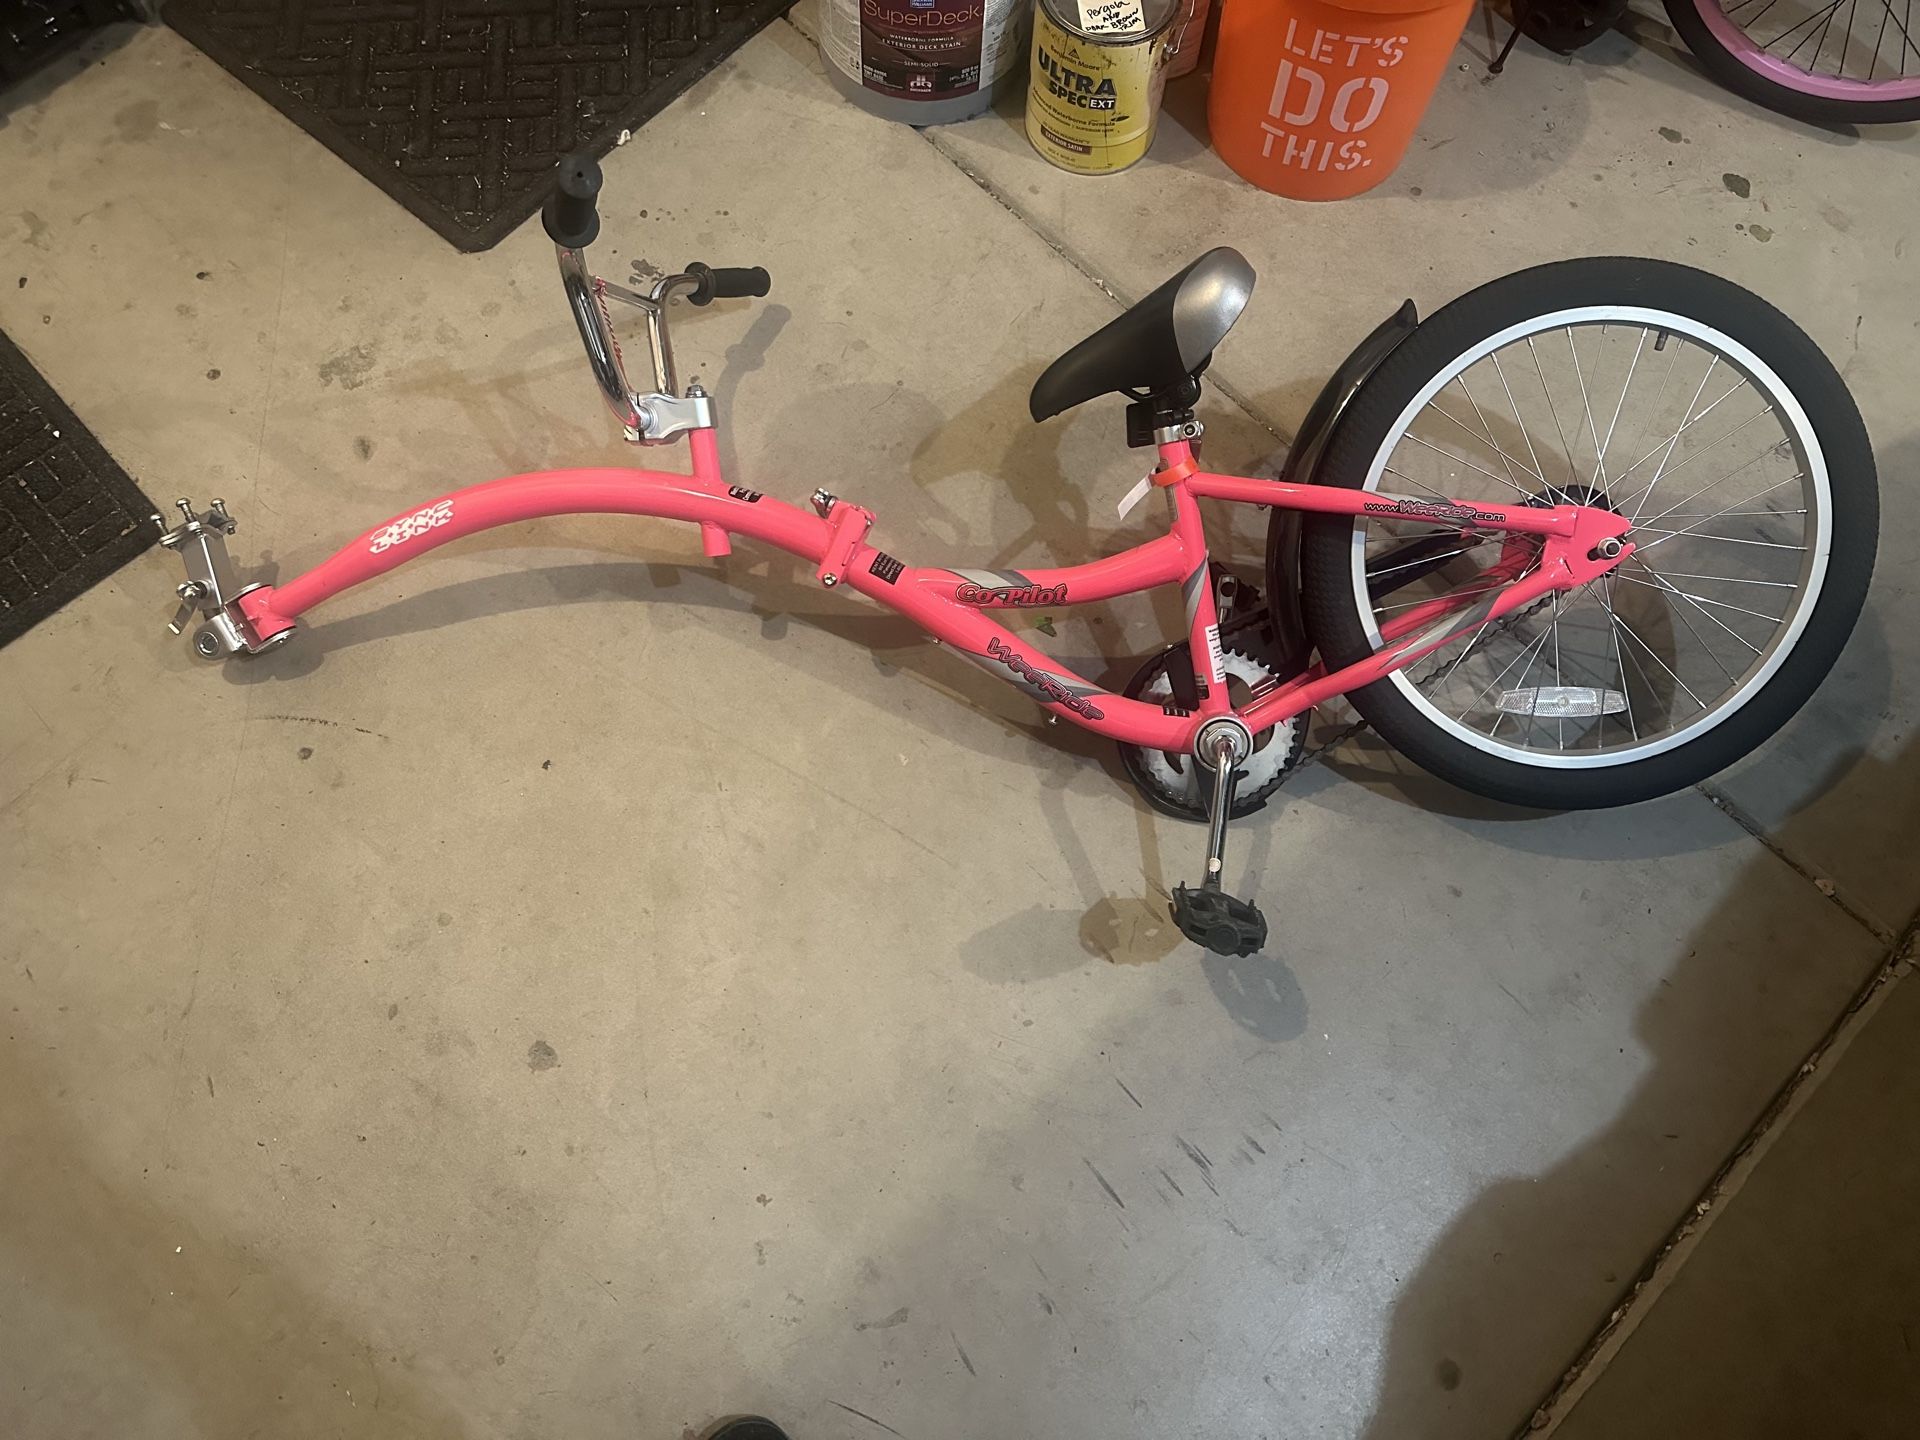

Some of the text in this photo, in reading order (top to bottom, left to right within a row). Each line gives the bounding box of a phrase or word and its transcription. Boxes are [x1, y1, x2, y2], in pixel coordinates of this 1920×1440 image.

[1110, 8, 1139, 29] BROWN
[1118, 17, 1142, 31] TRIM
[881, 38, 916, 49] EXTERIOR
[940, 41, 961, 49] STAIN
[1283, 18, 1409, 68] LET'S
[1038, 45, 1117, 97] ULTRA
[1077, 60, 1101, 71] Moore
[1049, 80, 1088, 108] SPEC
[1090, 99, 1115, 109] EXT
[1267, 58, 1389, 133] DO
[1045, 131, 1083, 152] EXTERIOR SATIN
[1260, 121, 1373, 172] THIS.
[987, 637, 1105, 720] WeeRide
